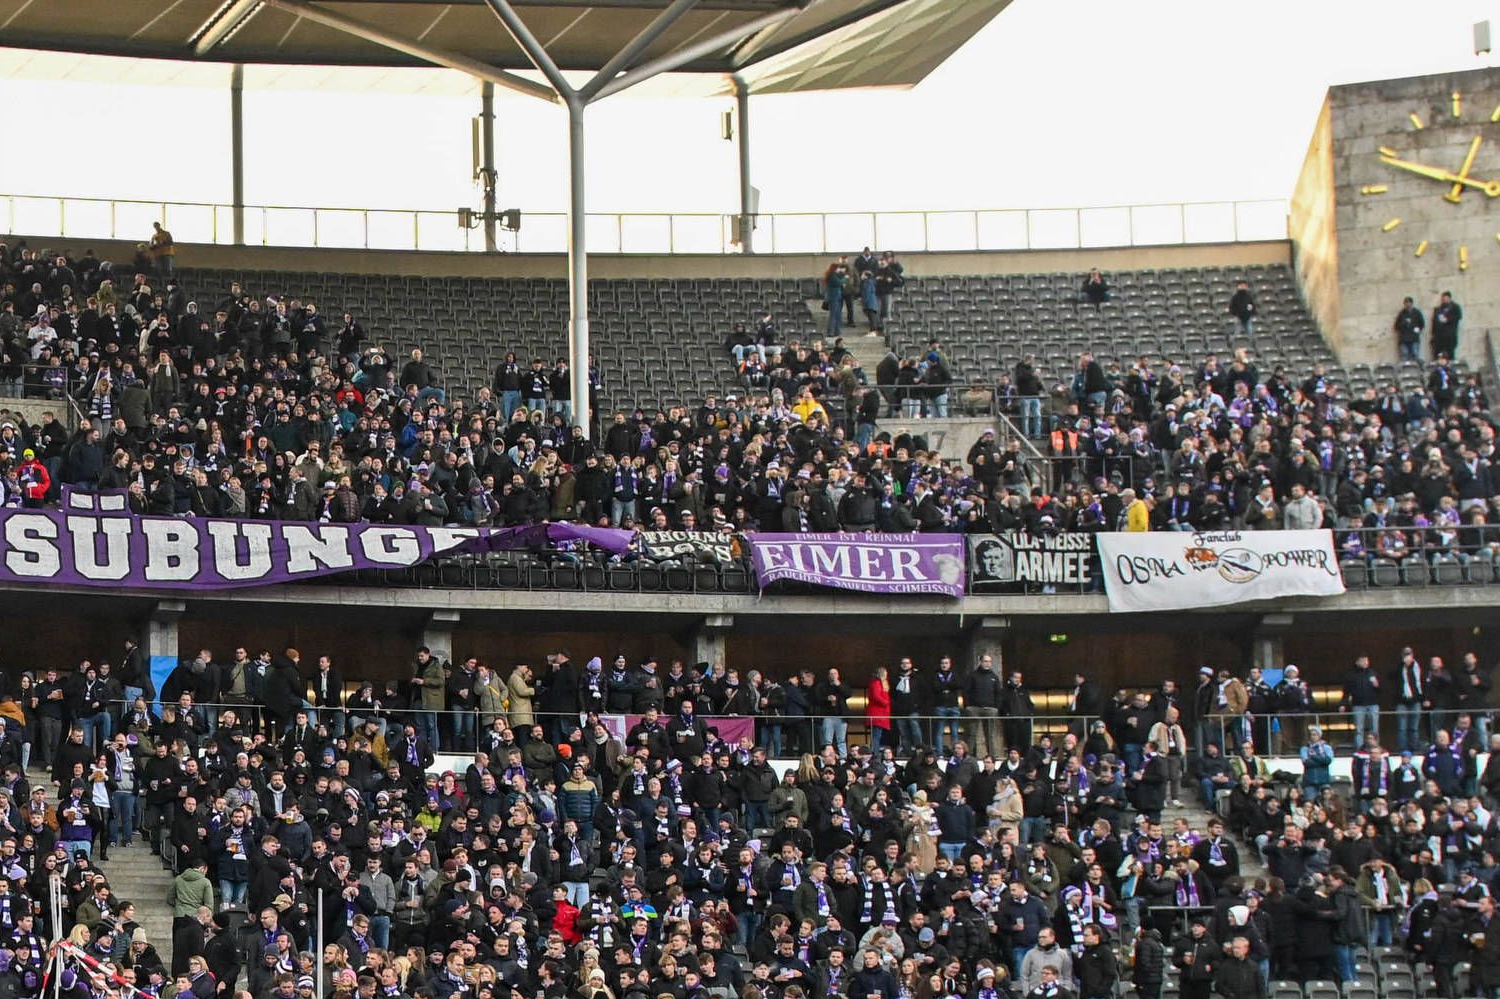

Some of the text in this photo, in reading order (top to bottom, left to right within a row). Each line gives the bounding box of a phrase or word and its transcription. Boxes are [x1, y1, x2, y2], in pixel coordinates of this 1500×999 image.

[796, 533, 832, 541] EIMER
[839, 533, 856, 541] IST
[1193, 531, 1242, 546] Fanclub
[756, 543, 928, 581] EIMER
[1015, 551, 1092, 583] ARMEE
[1116, 549, 1338, 585] OSNA POWER
[768, 571, 822, 584] RAUCHEN
